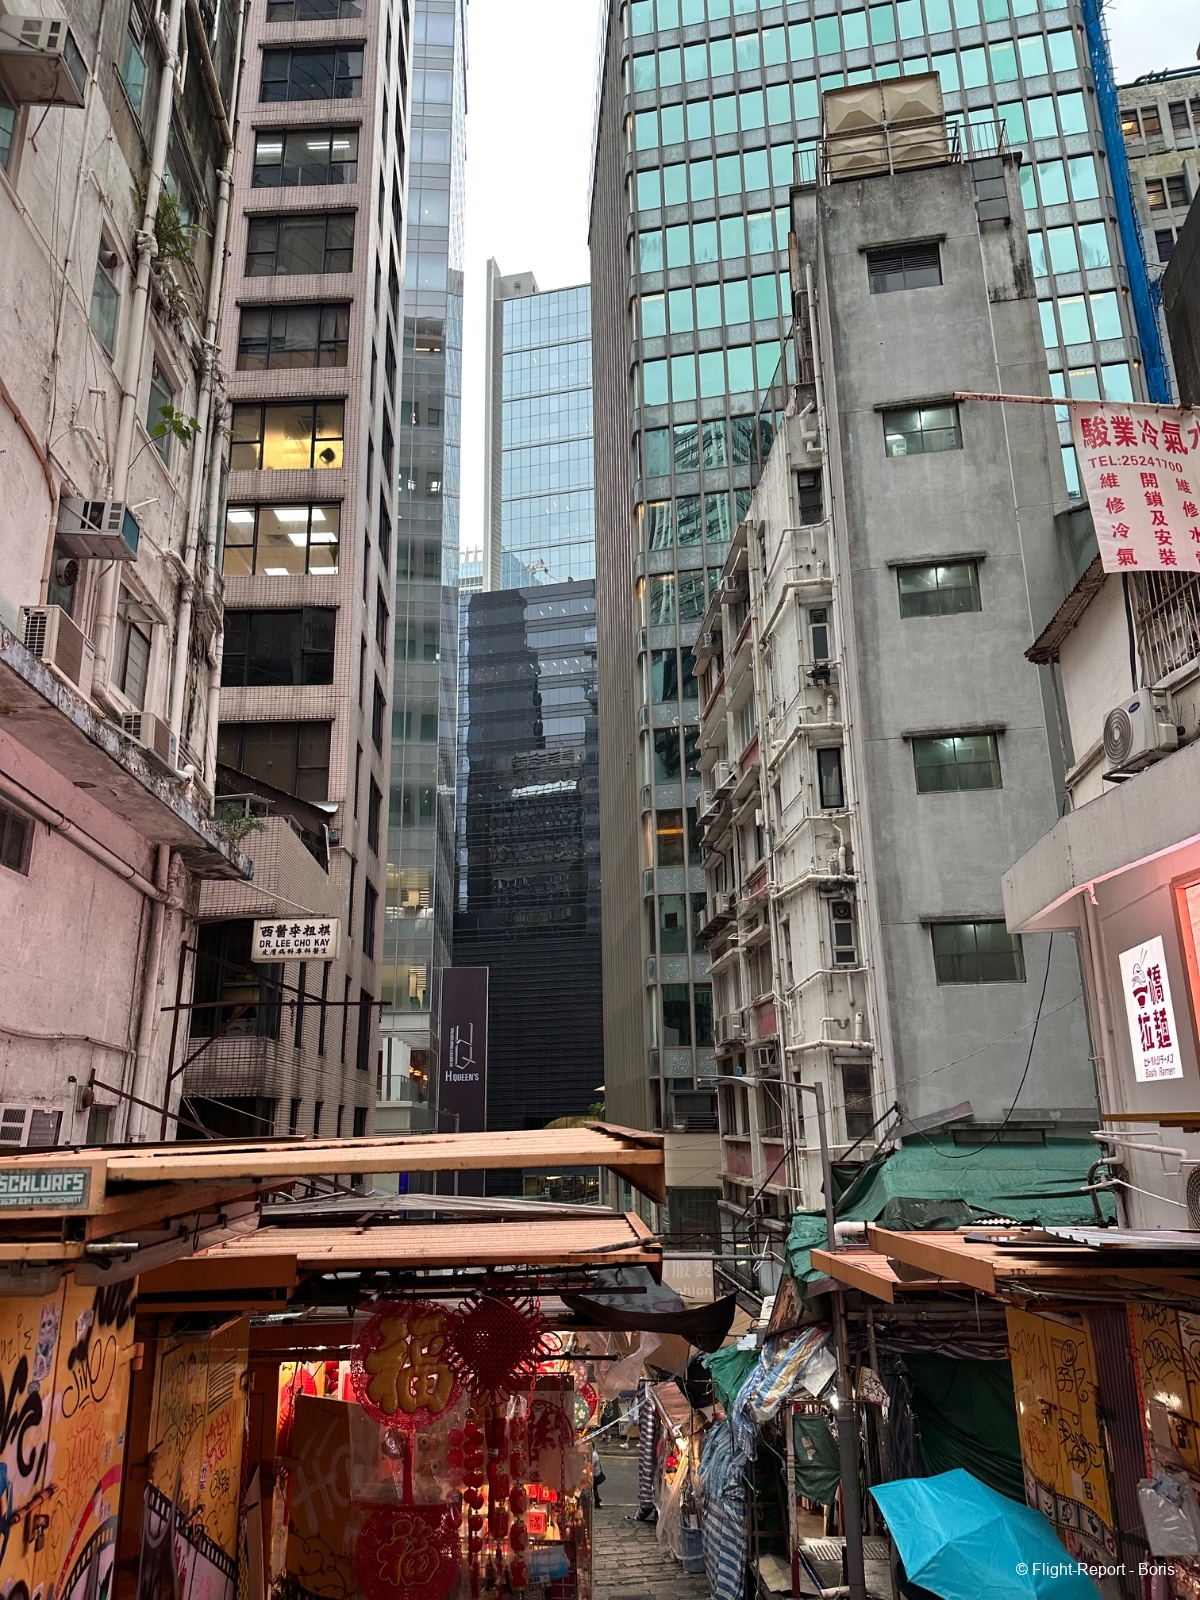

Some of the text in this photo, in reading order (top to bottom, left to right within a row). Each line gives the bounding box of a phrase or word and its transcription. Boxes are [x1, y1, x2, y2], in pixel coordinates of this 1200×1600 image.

[1176, 477, 1200, 566] 維修水
[259, 938, 331, 948] DR. LEE CHO KAY
[1159, 1066, 1176, 1076] Ramen
